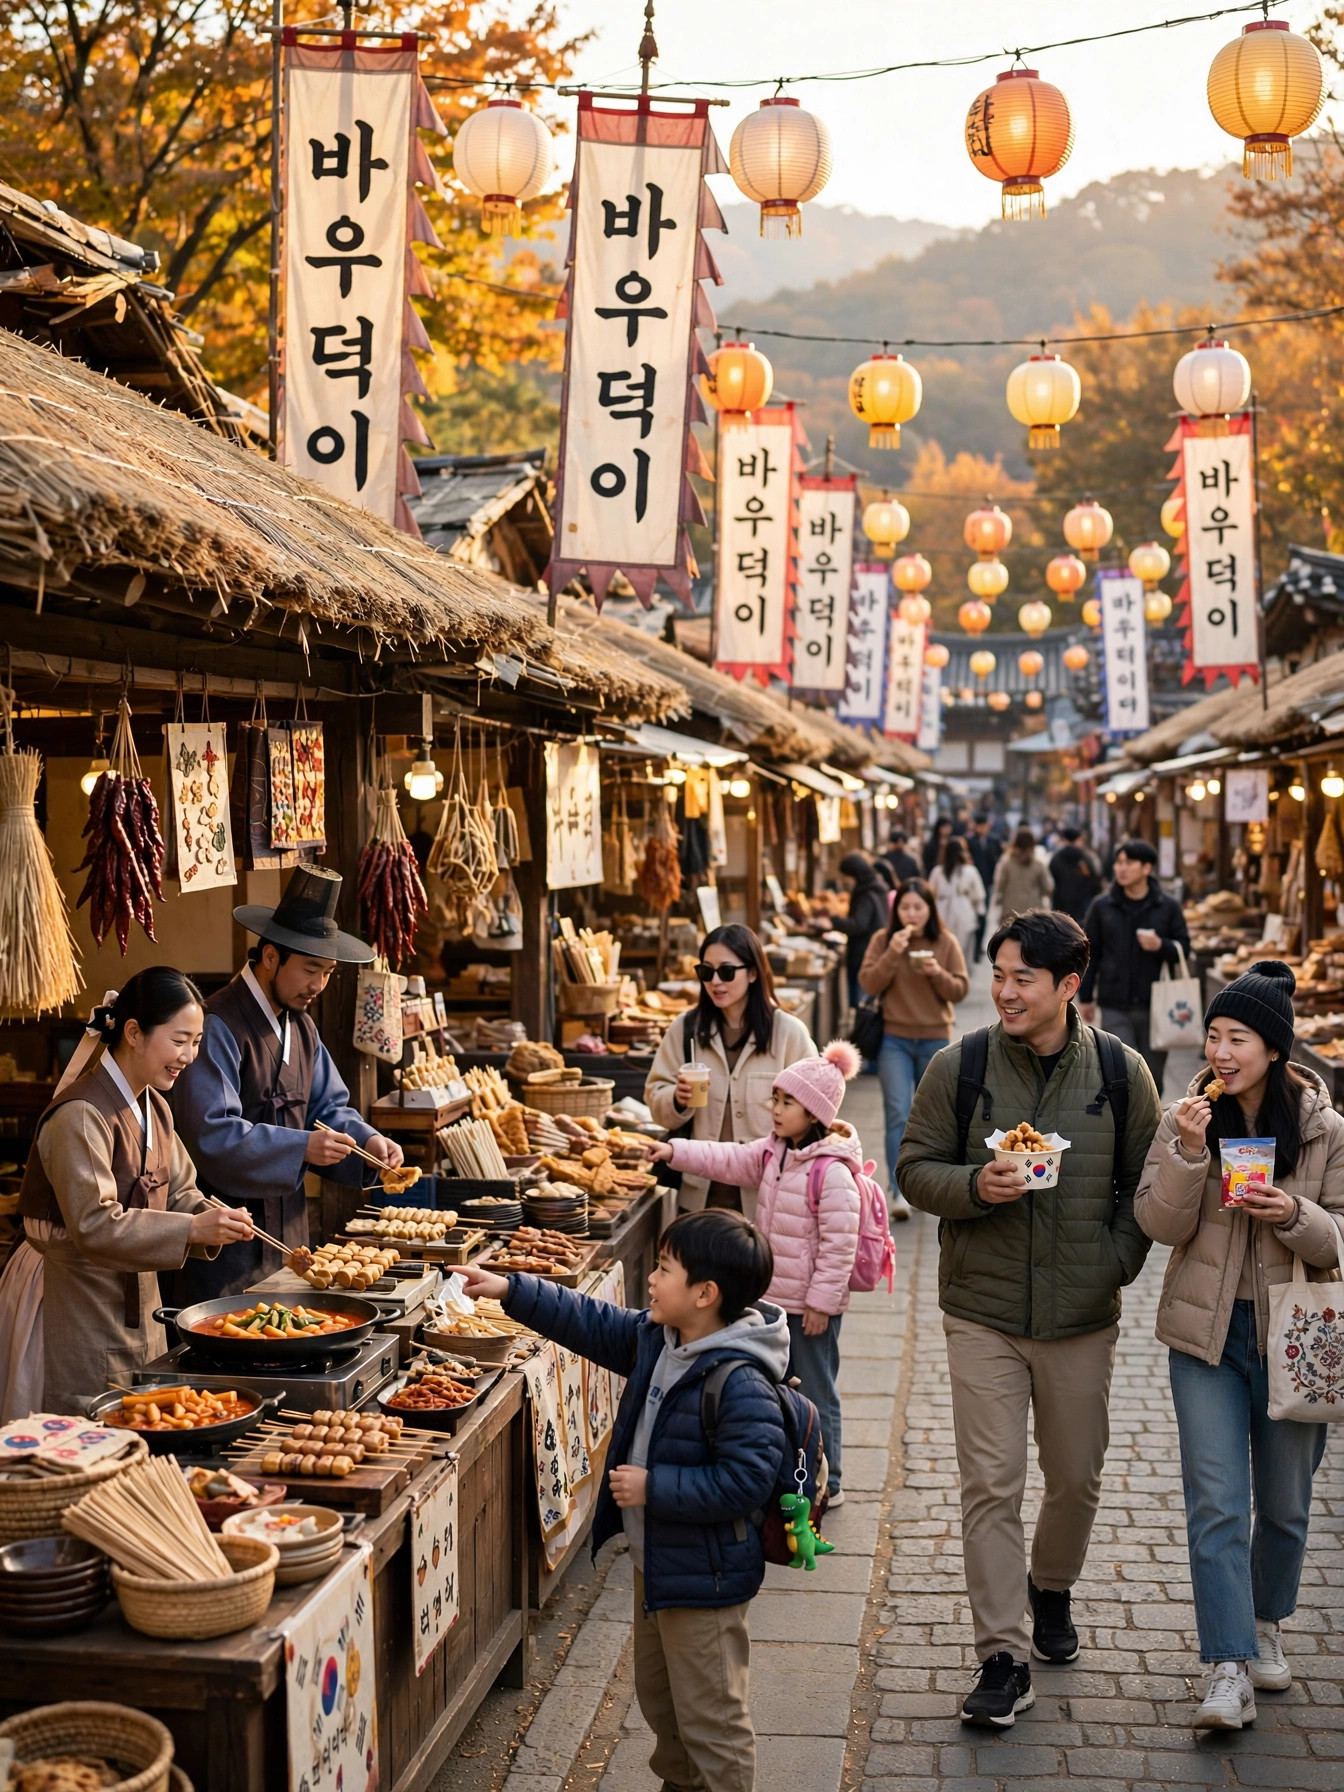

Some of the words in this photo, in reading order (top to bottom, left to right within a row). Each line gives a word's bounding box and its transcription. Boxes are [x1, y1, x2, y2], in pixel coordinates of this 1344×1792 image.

[305, 119, 389, 492] 바우덕이
[591, 182, 677, 523] 바우덕이
[734, 448, 777, 635] 바우덕이
[807, 512, 842, 667] 바우덕이
[1200, 459, 1239, 637] 바우덕이
